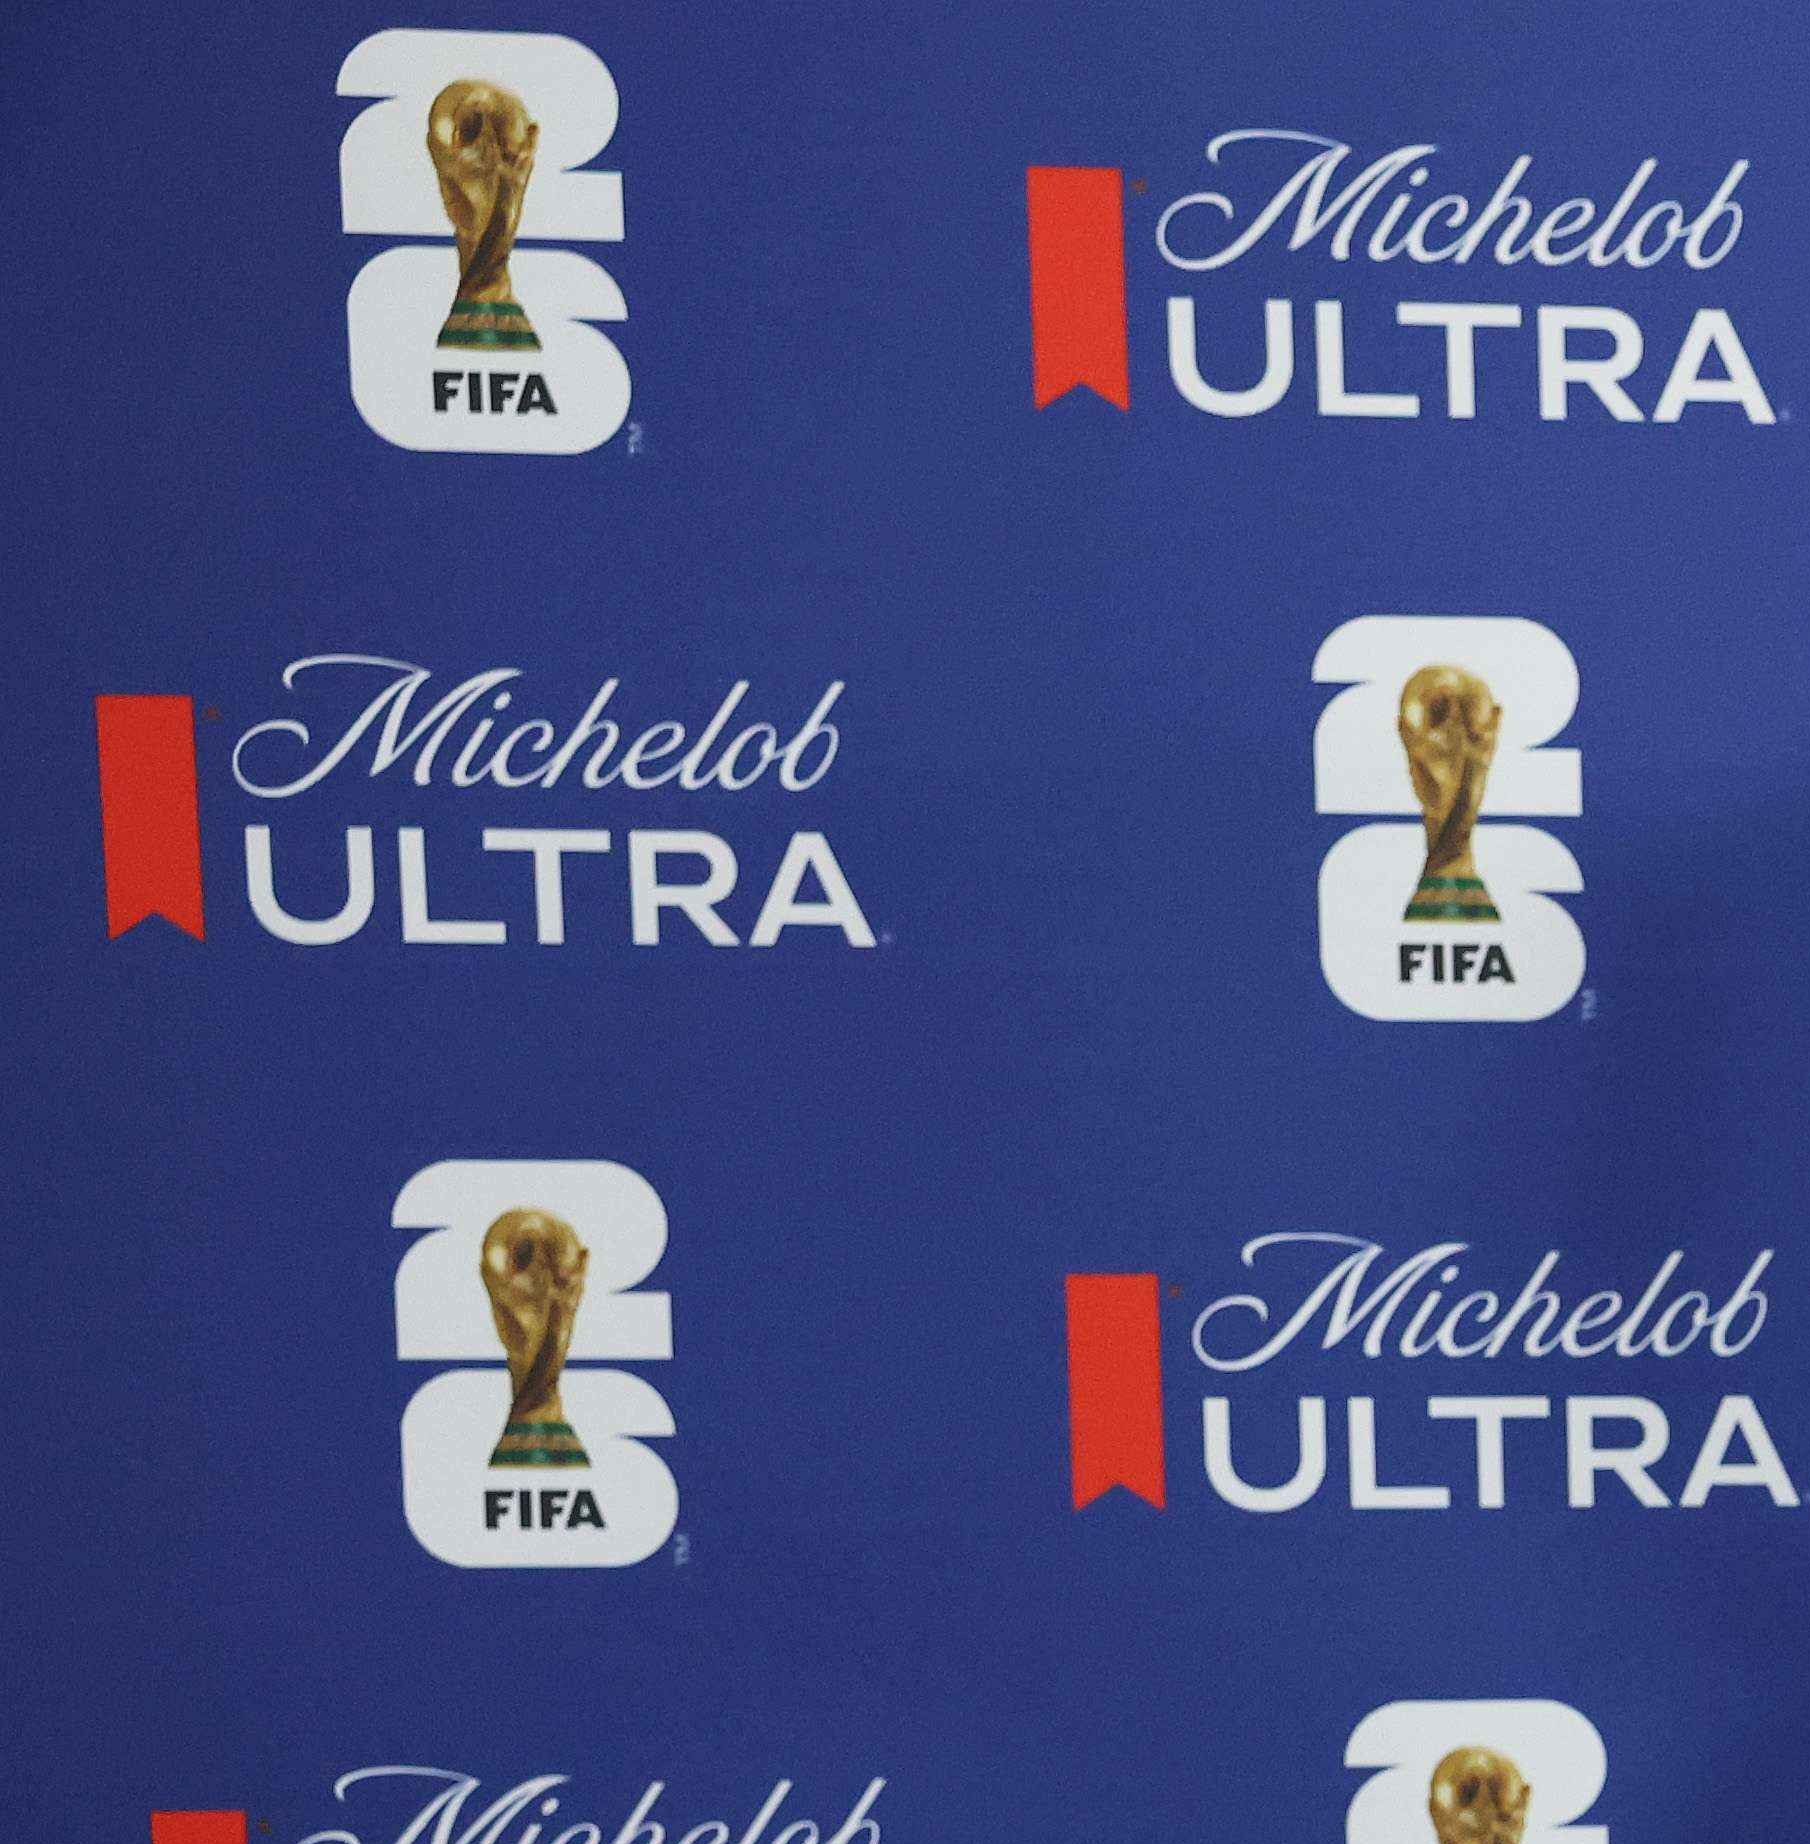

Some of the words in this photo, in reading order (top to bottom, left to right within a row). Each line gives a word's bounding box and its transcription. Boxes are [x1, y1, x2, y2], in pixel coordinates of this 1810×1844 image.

[1156, 129, 1749, 271] Michelob
[433, 371, 557, 414] FIFA
[1168, 298, 1776, 424] ULTRA
[232, 654, 845, 798] Michelob
[245, 826, 875, 948] ULTRA
[1399, 944, 1515, 983] FIFA
[1192, 1230, 1773, 1372] Michelob
[485, 1490, 605, 1529] FIFA
[1203, 1396, 1798, 1511] ULTRA
